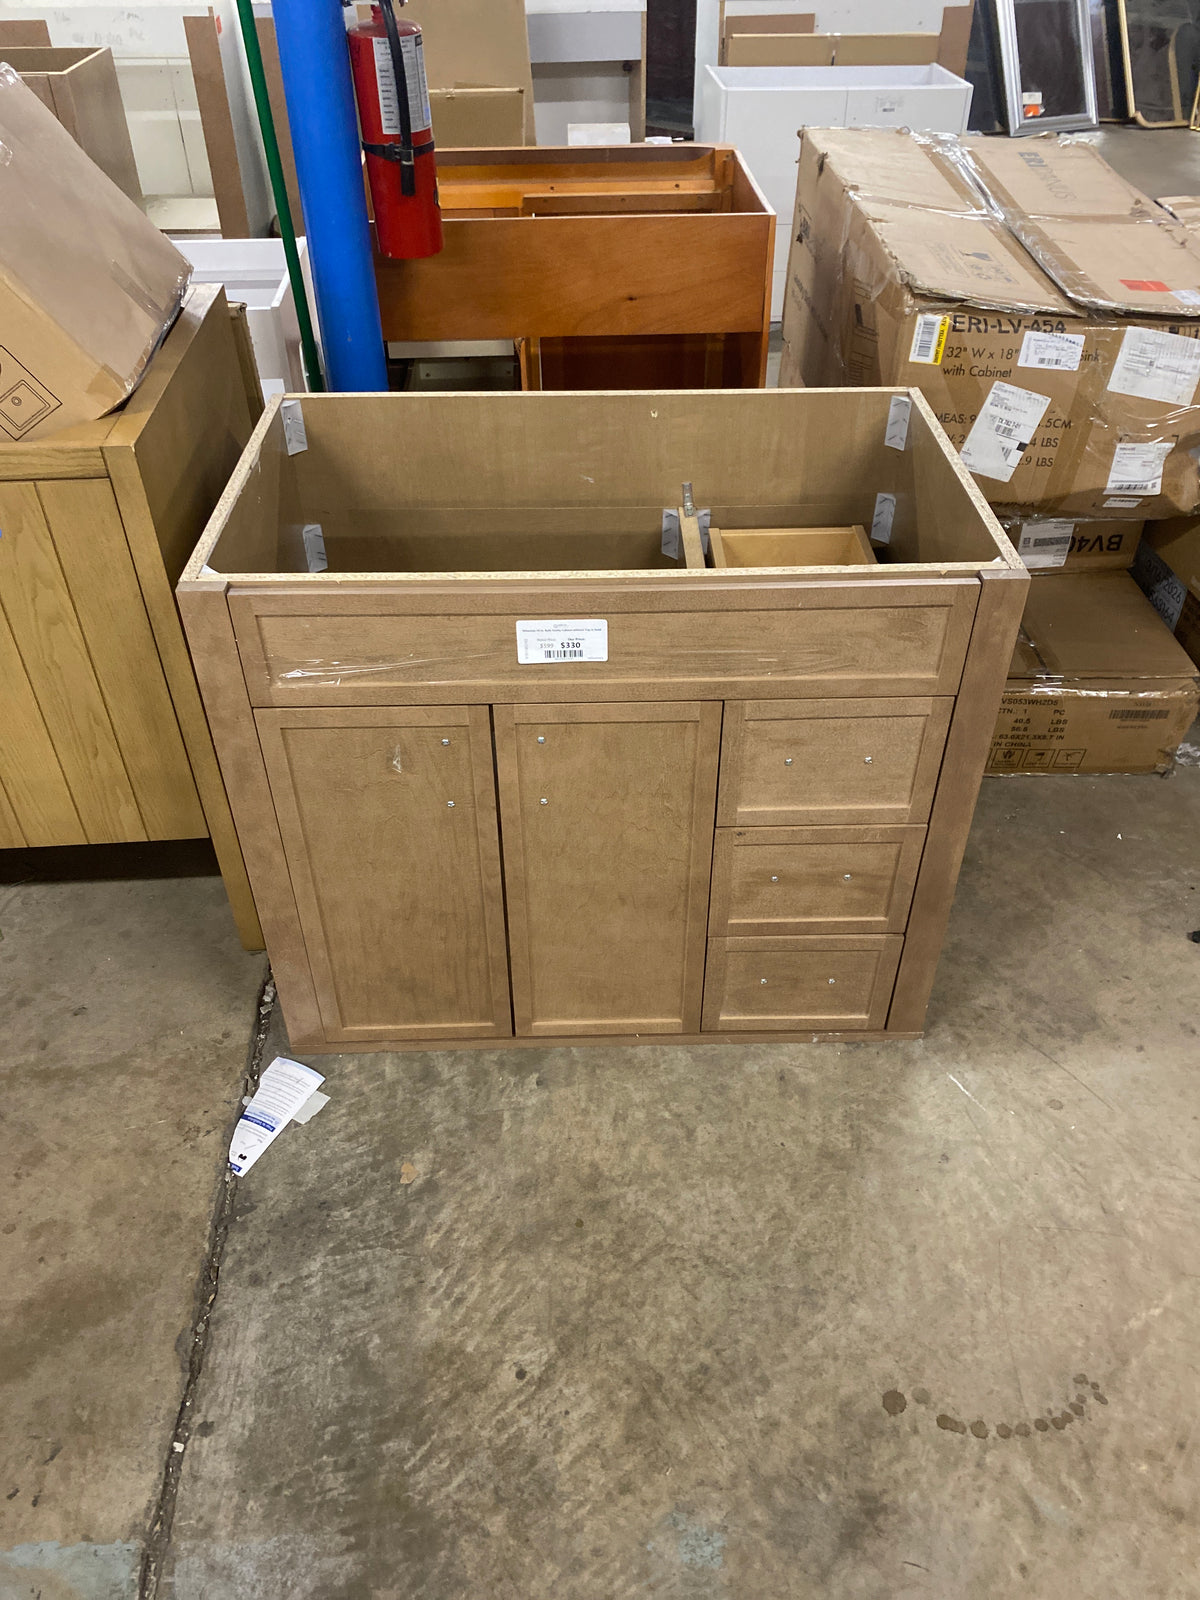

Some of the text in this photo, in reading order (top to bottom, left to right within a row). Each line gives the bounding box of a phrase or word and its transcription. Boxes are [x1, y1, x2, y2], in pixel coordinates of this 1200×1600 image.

[946, 347, 968, 359] 32"
[972, 349, 986, 359] W
[987, 351, 995, 360] x
[1000, 349, 1019, 360] 18"
[943, 363, 1012, 379] with Cabinet
[1041, 438, 1059, 448] LBS
[1036, 457, 1054, 467] LBS
